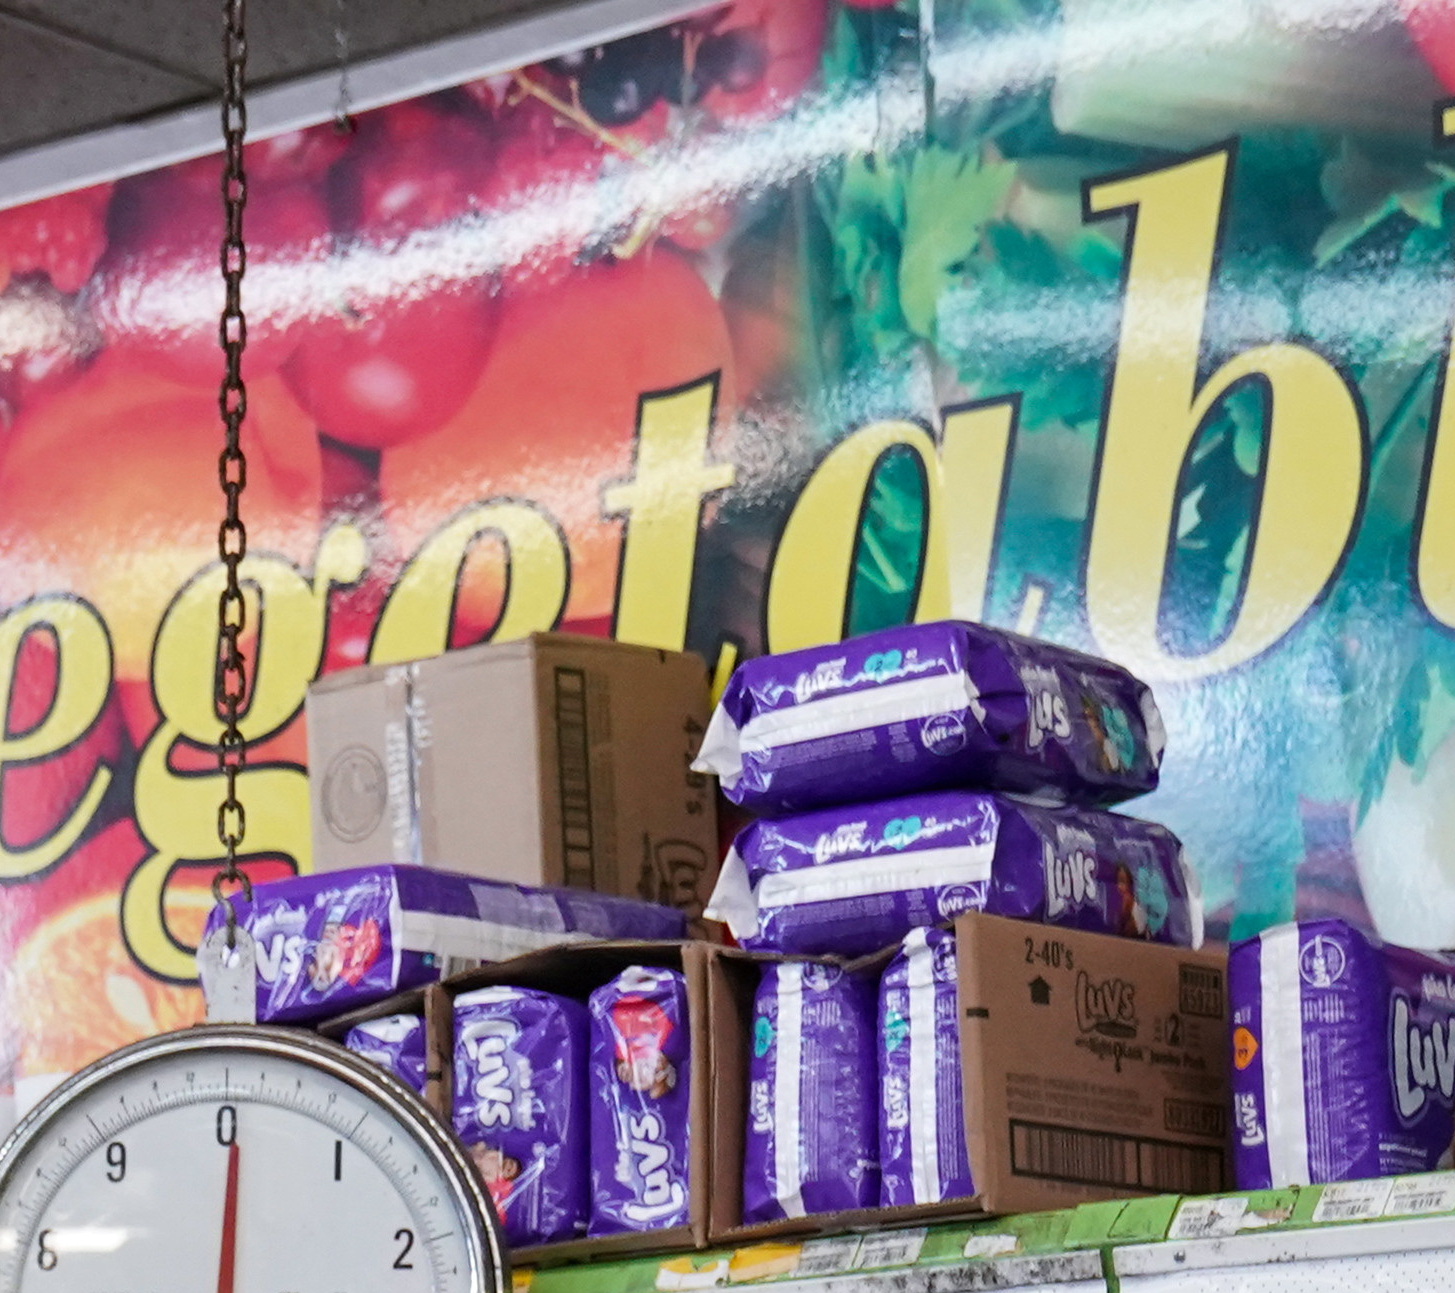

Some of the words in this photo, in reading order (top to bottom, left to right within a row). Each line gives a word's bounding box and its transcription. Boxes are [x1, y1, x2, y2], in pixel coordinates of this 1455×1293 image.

[215, 1105, 237, 1147] 0
[105, 1140, 127, 1184] 9
[393, 1229, 414, 1271] 2
